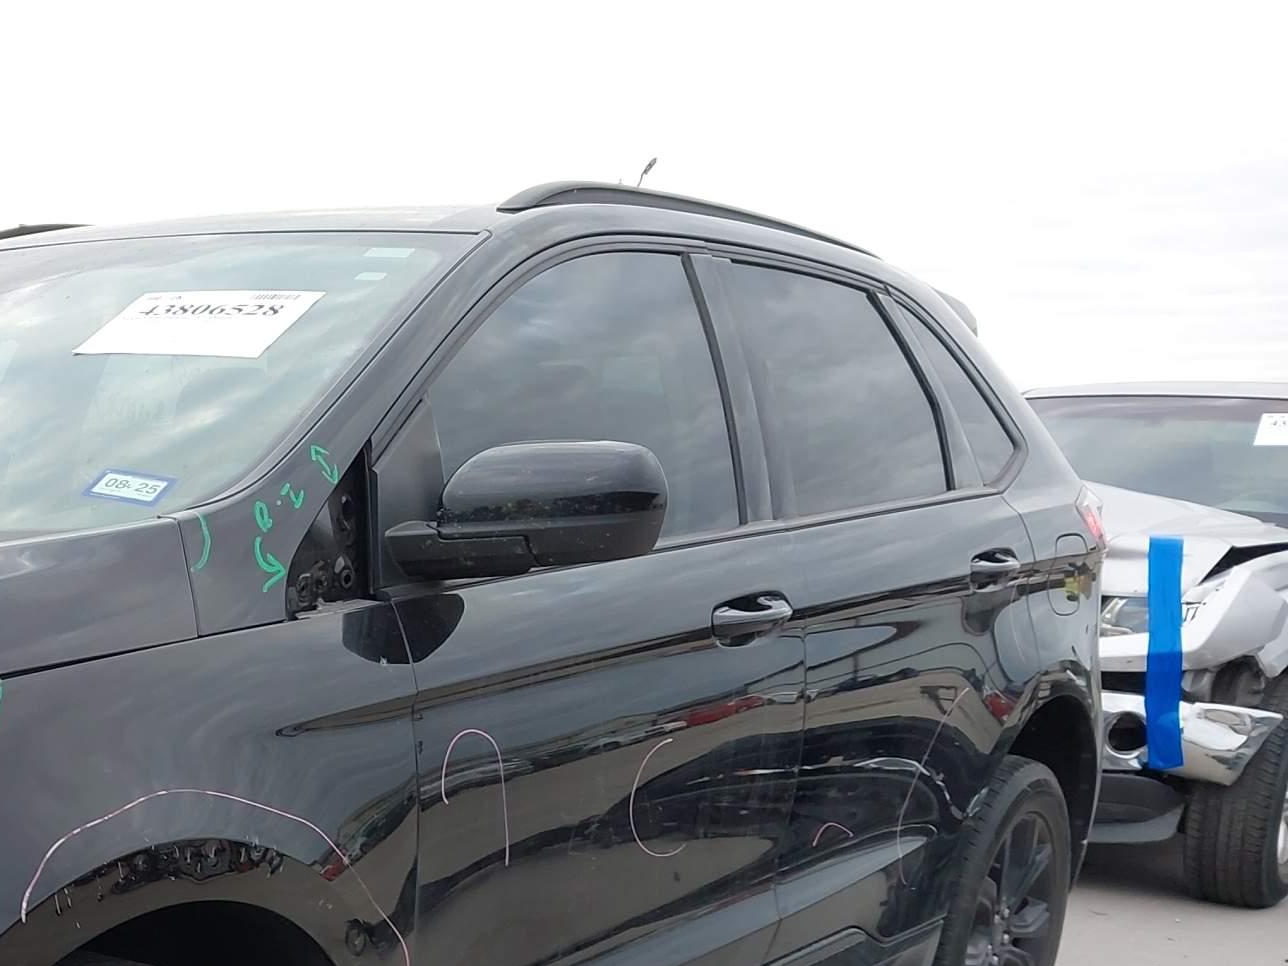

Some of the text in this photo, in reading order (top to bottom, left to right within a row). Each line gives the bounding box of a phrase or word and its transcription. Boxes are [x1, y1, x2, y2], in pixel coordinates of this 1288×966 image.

[139, 304, 284, 316] 43806528
[104, 477, 162, 495] 08 25
